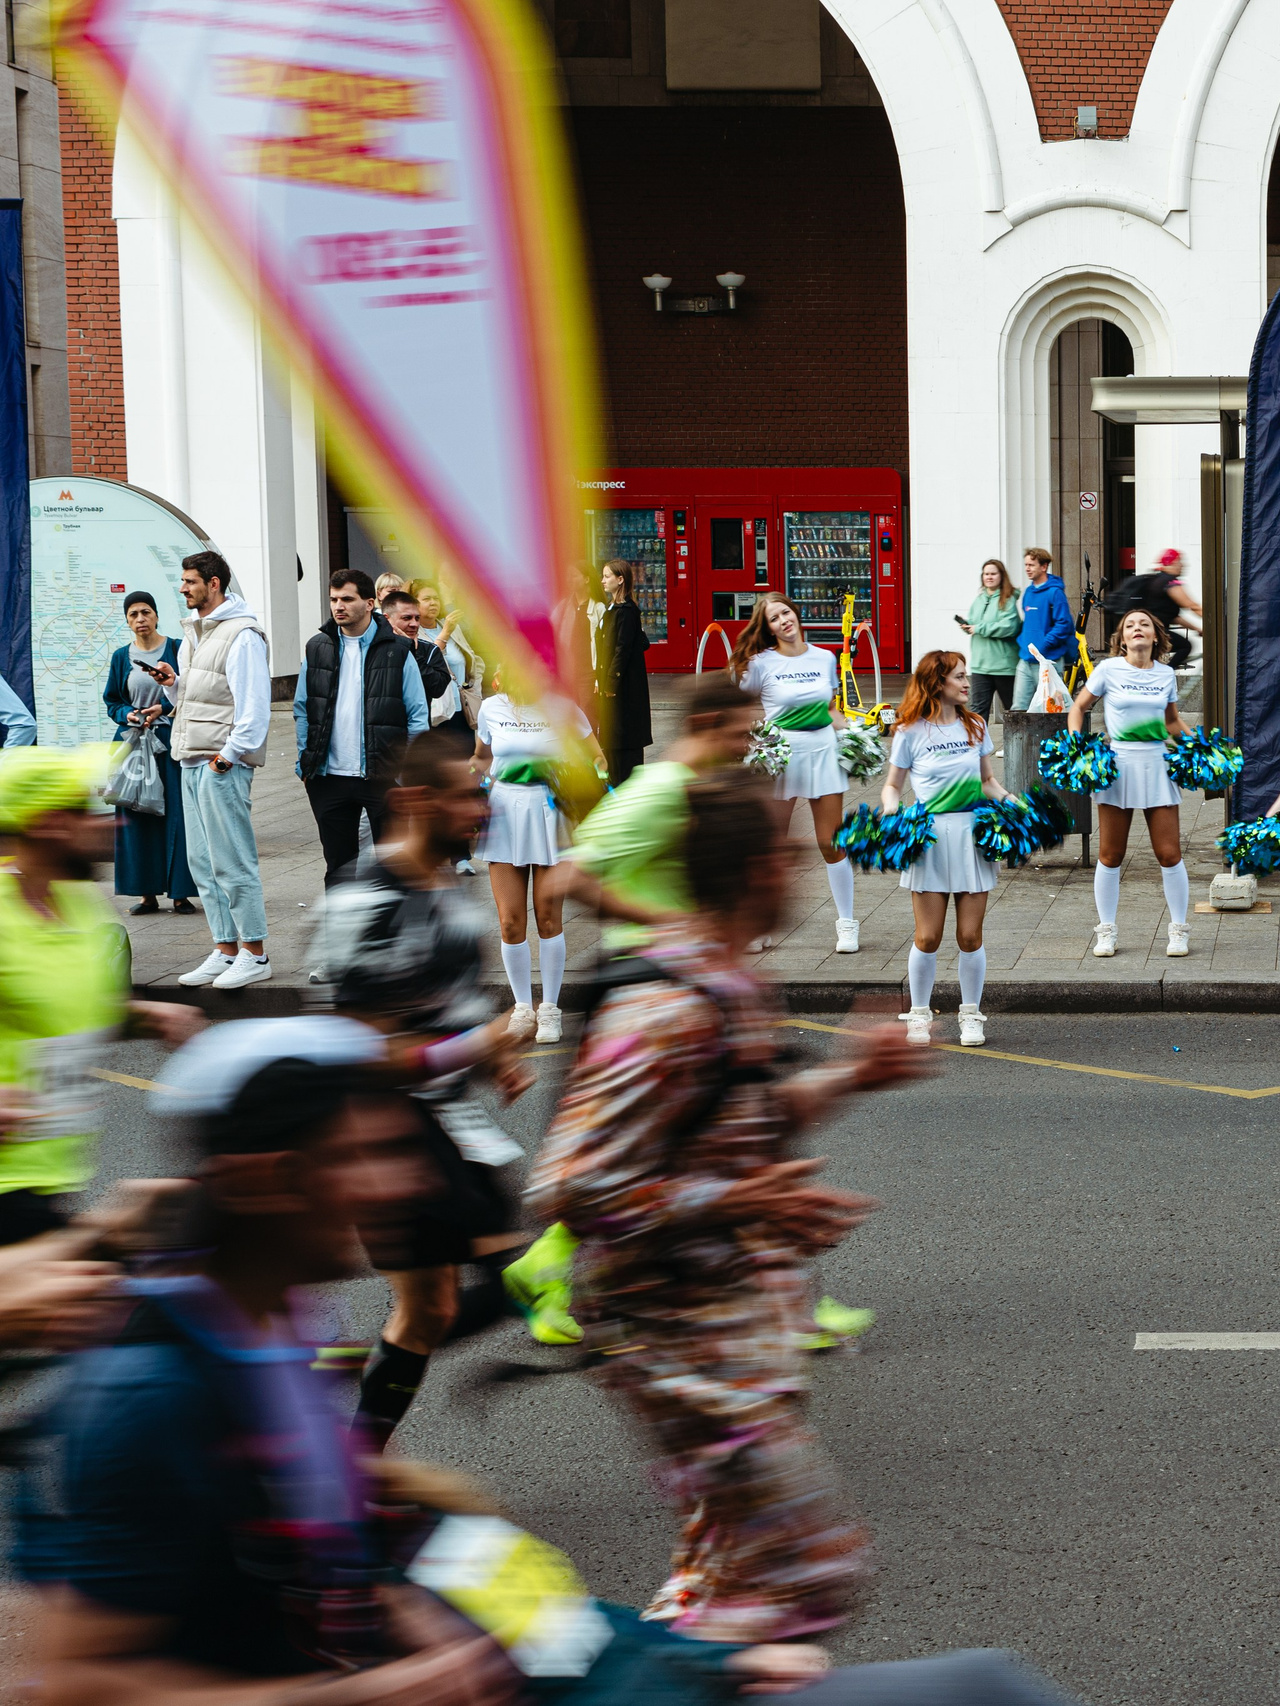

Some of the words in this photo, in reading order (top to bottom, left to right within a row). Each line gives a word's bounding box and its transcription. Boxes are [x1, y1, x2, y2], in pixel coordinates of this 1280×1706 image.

[43, 505, 74, 513] Цветной
[74, 505, 104, 513] бульвар
[775, 671, 821, 680] УРАЛХИМ
